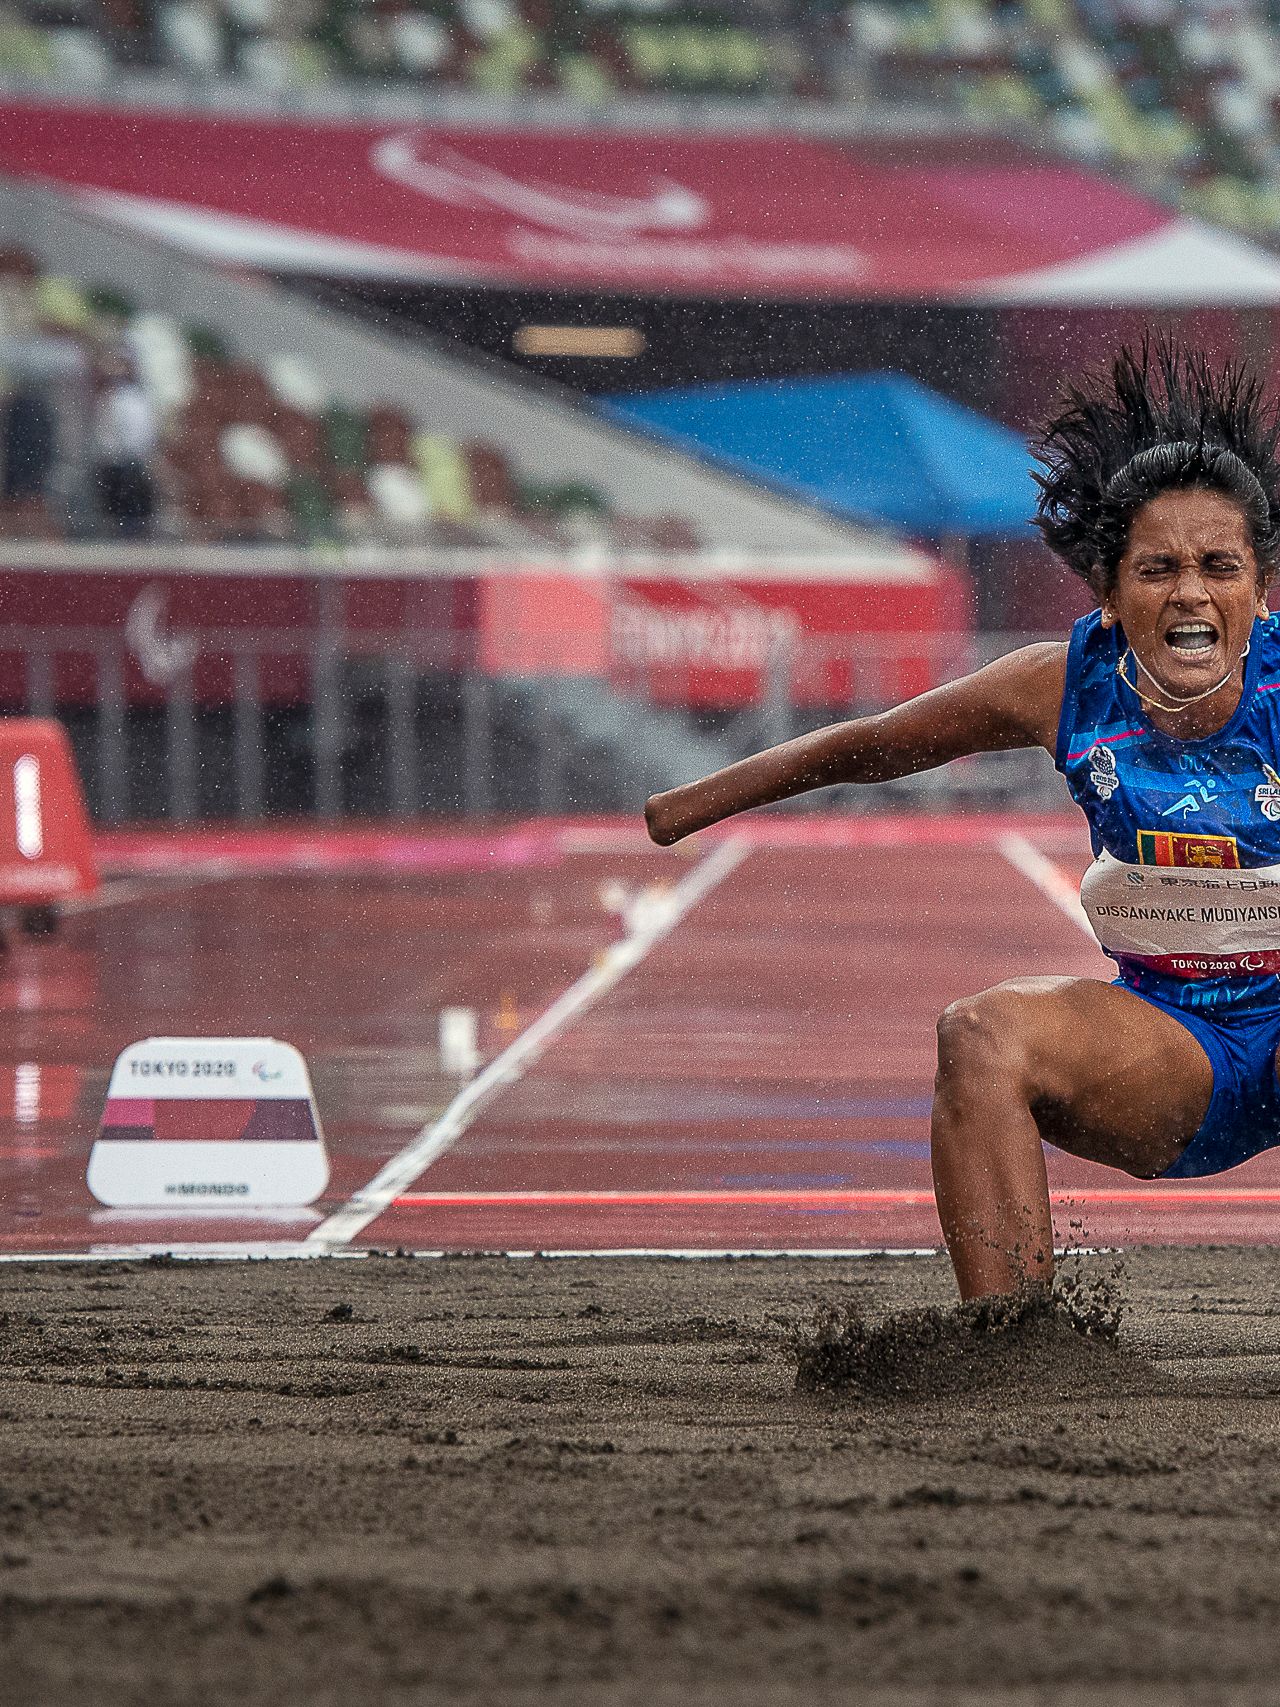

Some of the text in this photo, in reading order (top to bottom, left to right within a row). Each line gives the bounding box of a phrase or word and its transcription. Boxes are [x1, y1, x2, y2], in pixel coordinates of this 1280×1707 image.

[1096, 905, 1196, 922] DISSANAYAKE
[1171, 959, 1237, 970] TOKYO 2020
[130, 1060, 238, 1077] TOKYO 2020
